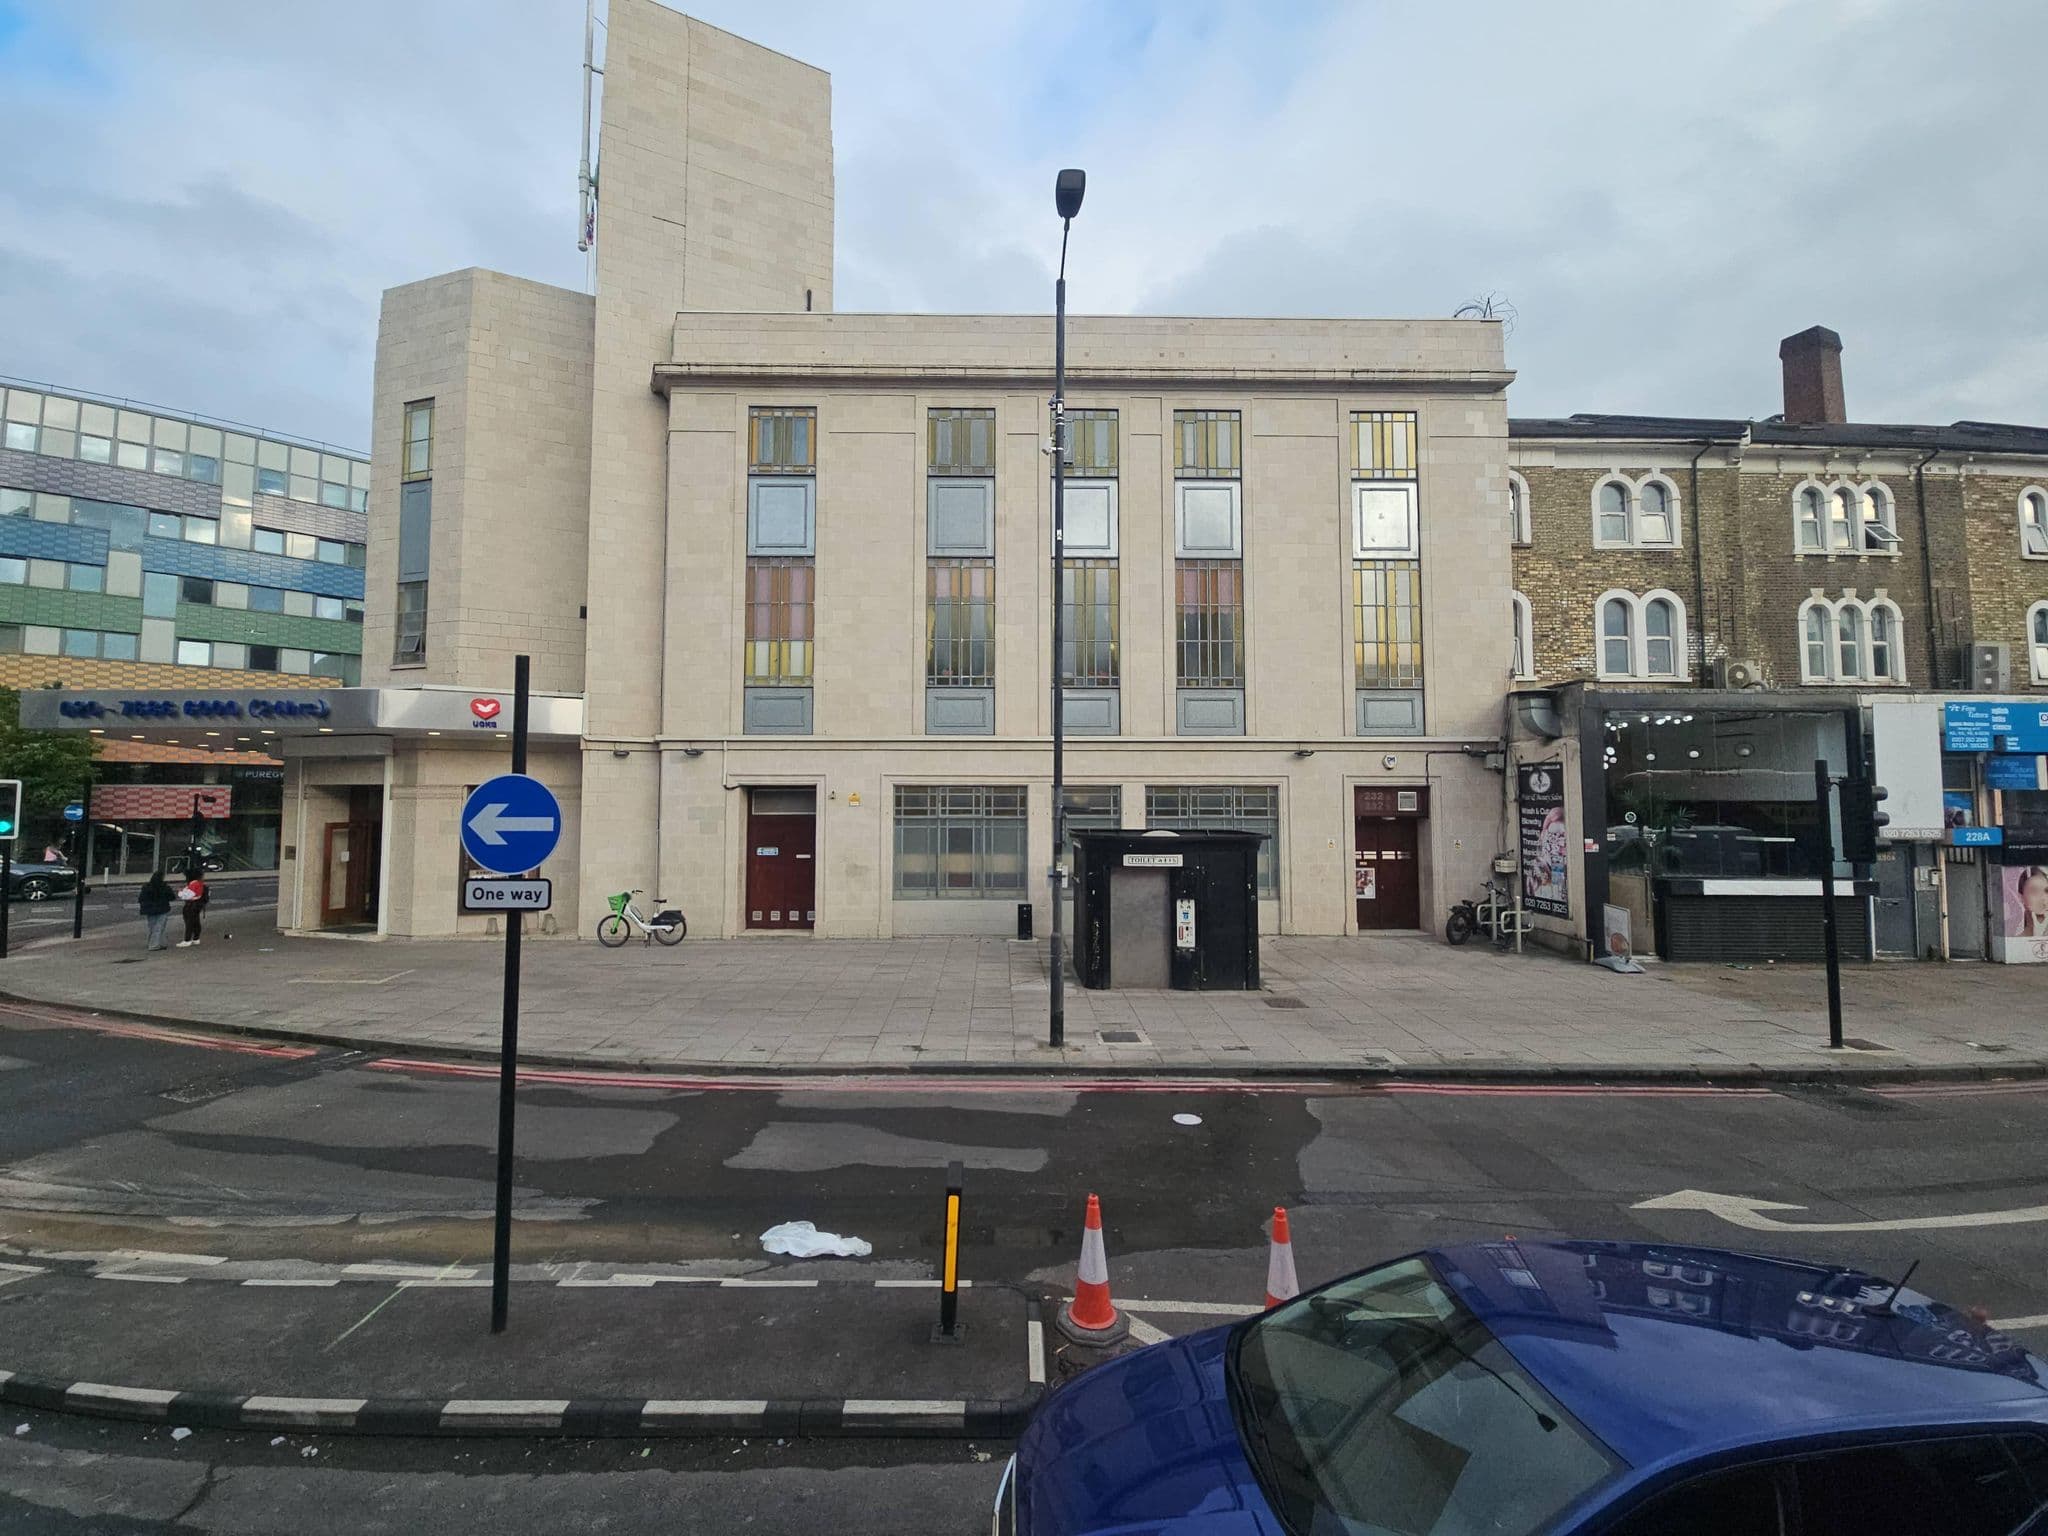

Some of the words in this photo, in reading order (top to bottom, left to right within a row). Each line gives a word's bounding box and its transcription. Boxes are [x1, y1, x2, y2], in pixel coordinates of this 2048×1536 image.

[1965, 832, 1991, 842] 228A
[472, 887, 505, 901] One
[511, 890, 543, 903] way
